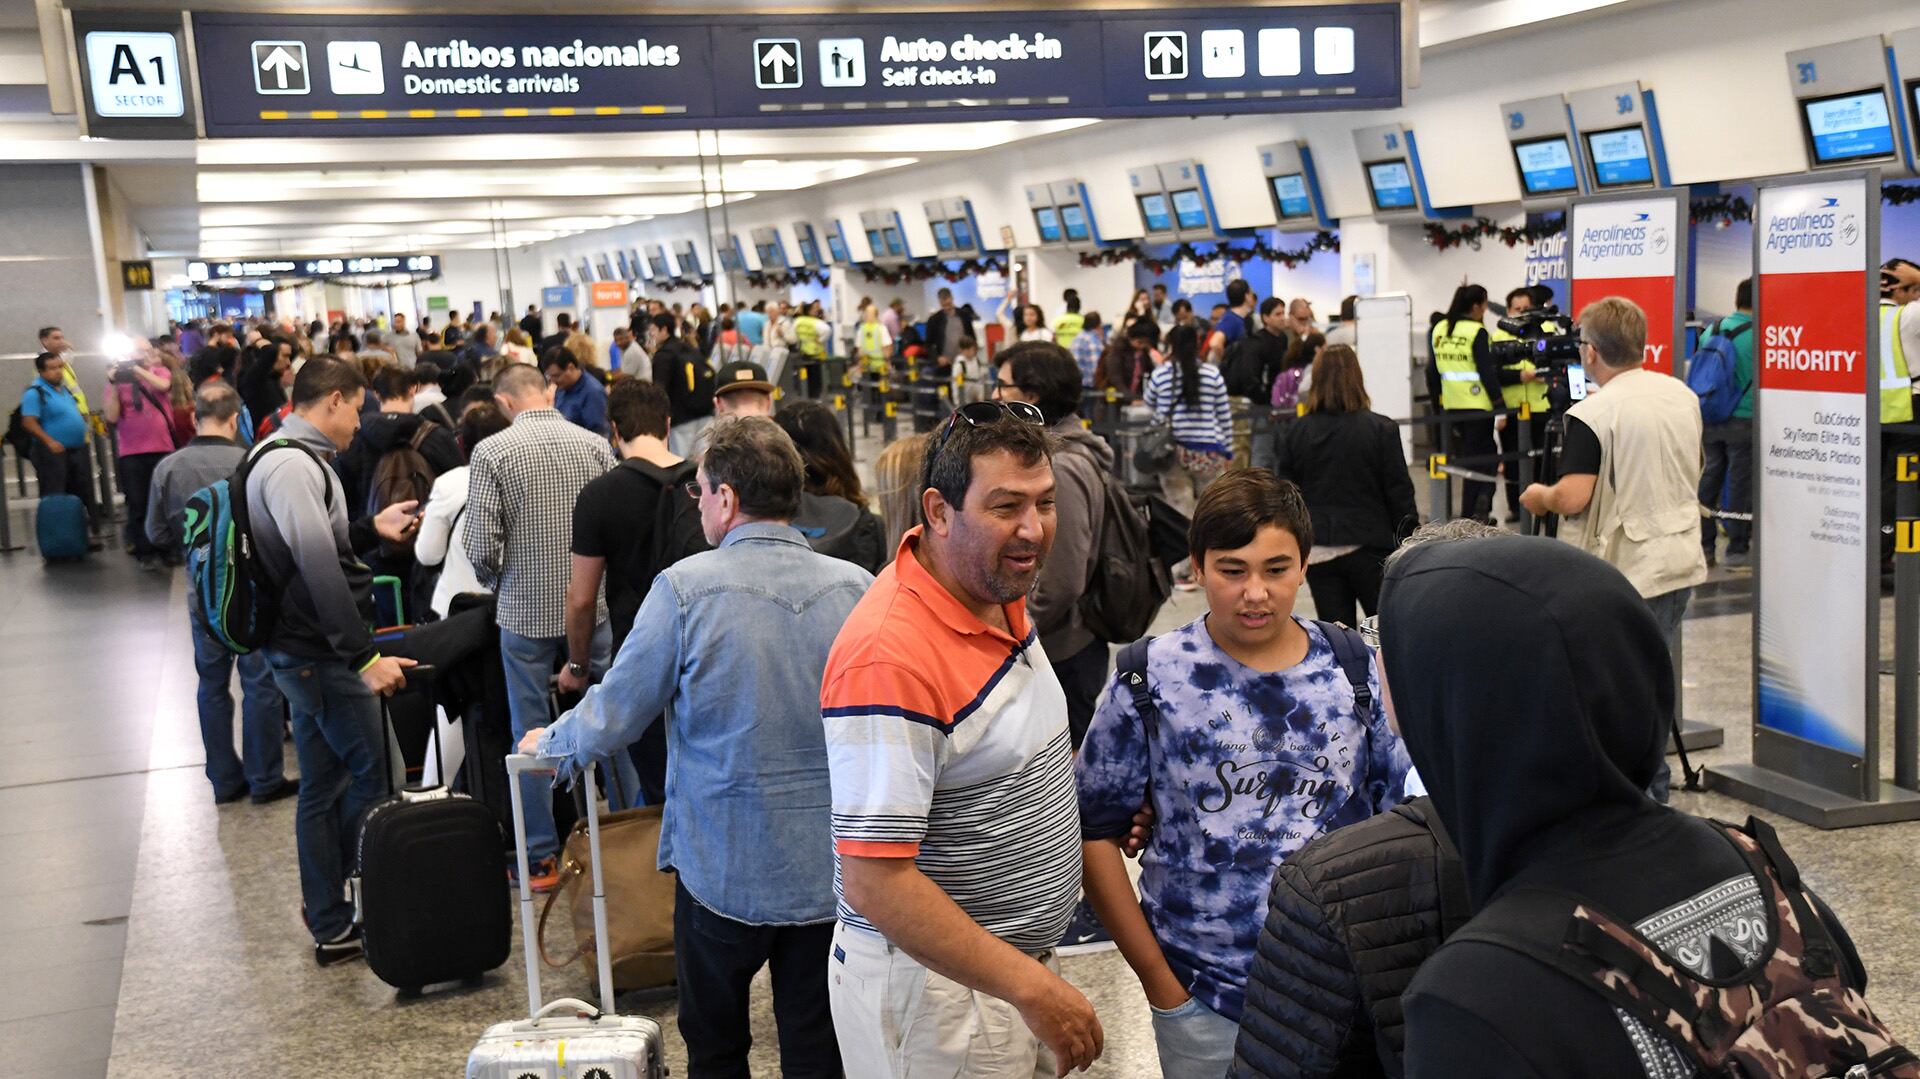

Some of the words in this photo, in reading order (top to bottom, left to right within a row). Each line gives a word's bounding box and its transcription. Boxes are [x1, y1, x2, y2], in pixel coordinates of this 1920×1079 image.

[402, 40, 516, 68] Arribos
[522, 38, 680, 67] nacionales
[880, 36, 947, 62] Auto
[950, 33, 1062, 61] check-in
[403, 73, 502, 94] Domestic
[506, 72, 580, 94] arrivals
[882, 66, 918, 87] Self
[920, 65, 996, 86] check-in
[1796, 62, 1816, 85] 31
[115, 95, 165, 106] SECTOR
[1615, 94, 1633, 114] 30
[1769, 210, 1836, 233] Aerolíneas
[1582, 224, 1647, 243] Aerolíneas
[1766, 231, 1834, 254] Argentinas
[1579, 241, 1644, 262] Argentinas
[1765, 325, 1803, 347] SKY
[1765, 349, 1857, 372] PRIORITY
[1783, 427, 1819, 443] SkyTeam
[1821, 431, 1840, 445] Elite
[1842, 432, 1861, 447] Plus
[1830, 449, 1861, 466] Platino
[1197, 756, 1337, 820] Surfing
